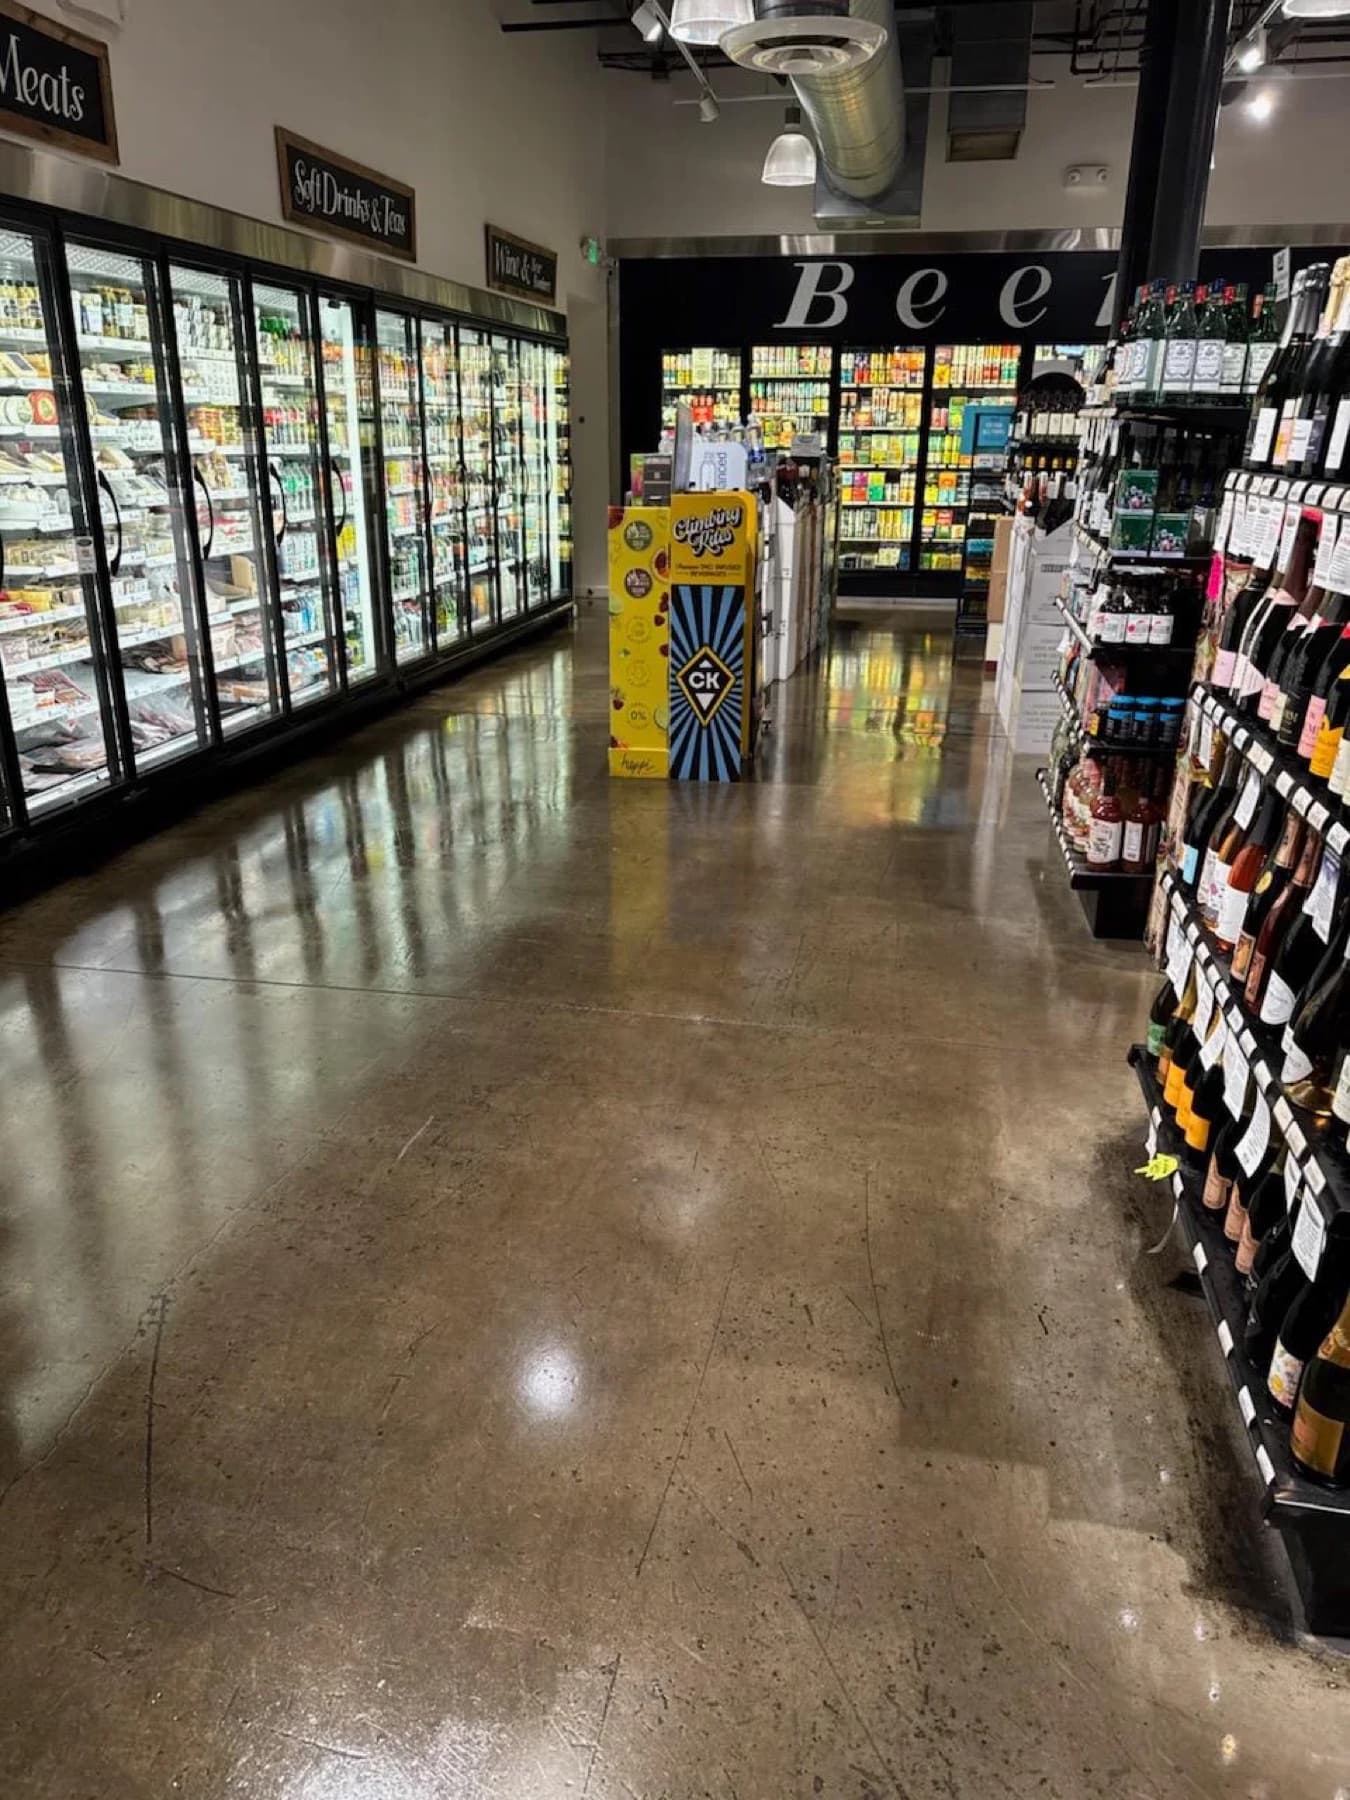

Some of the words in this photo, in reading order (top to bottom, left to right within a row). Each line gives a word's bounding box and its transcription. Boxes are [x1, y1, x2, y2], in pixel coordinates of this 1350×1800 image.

[0, 33, 85, 121] Meats
[293, 159, 321, 212] Soft
[321, 170, 370, 224] Drinks
[370, 198, 382, 233] &
[380, 194, 406, 236] Teas
[673, 506, 742, 543] Climbing
[688, 524, 734, 556] Kites
[688, 671, 720, 690] CK
